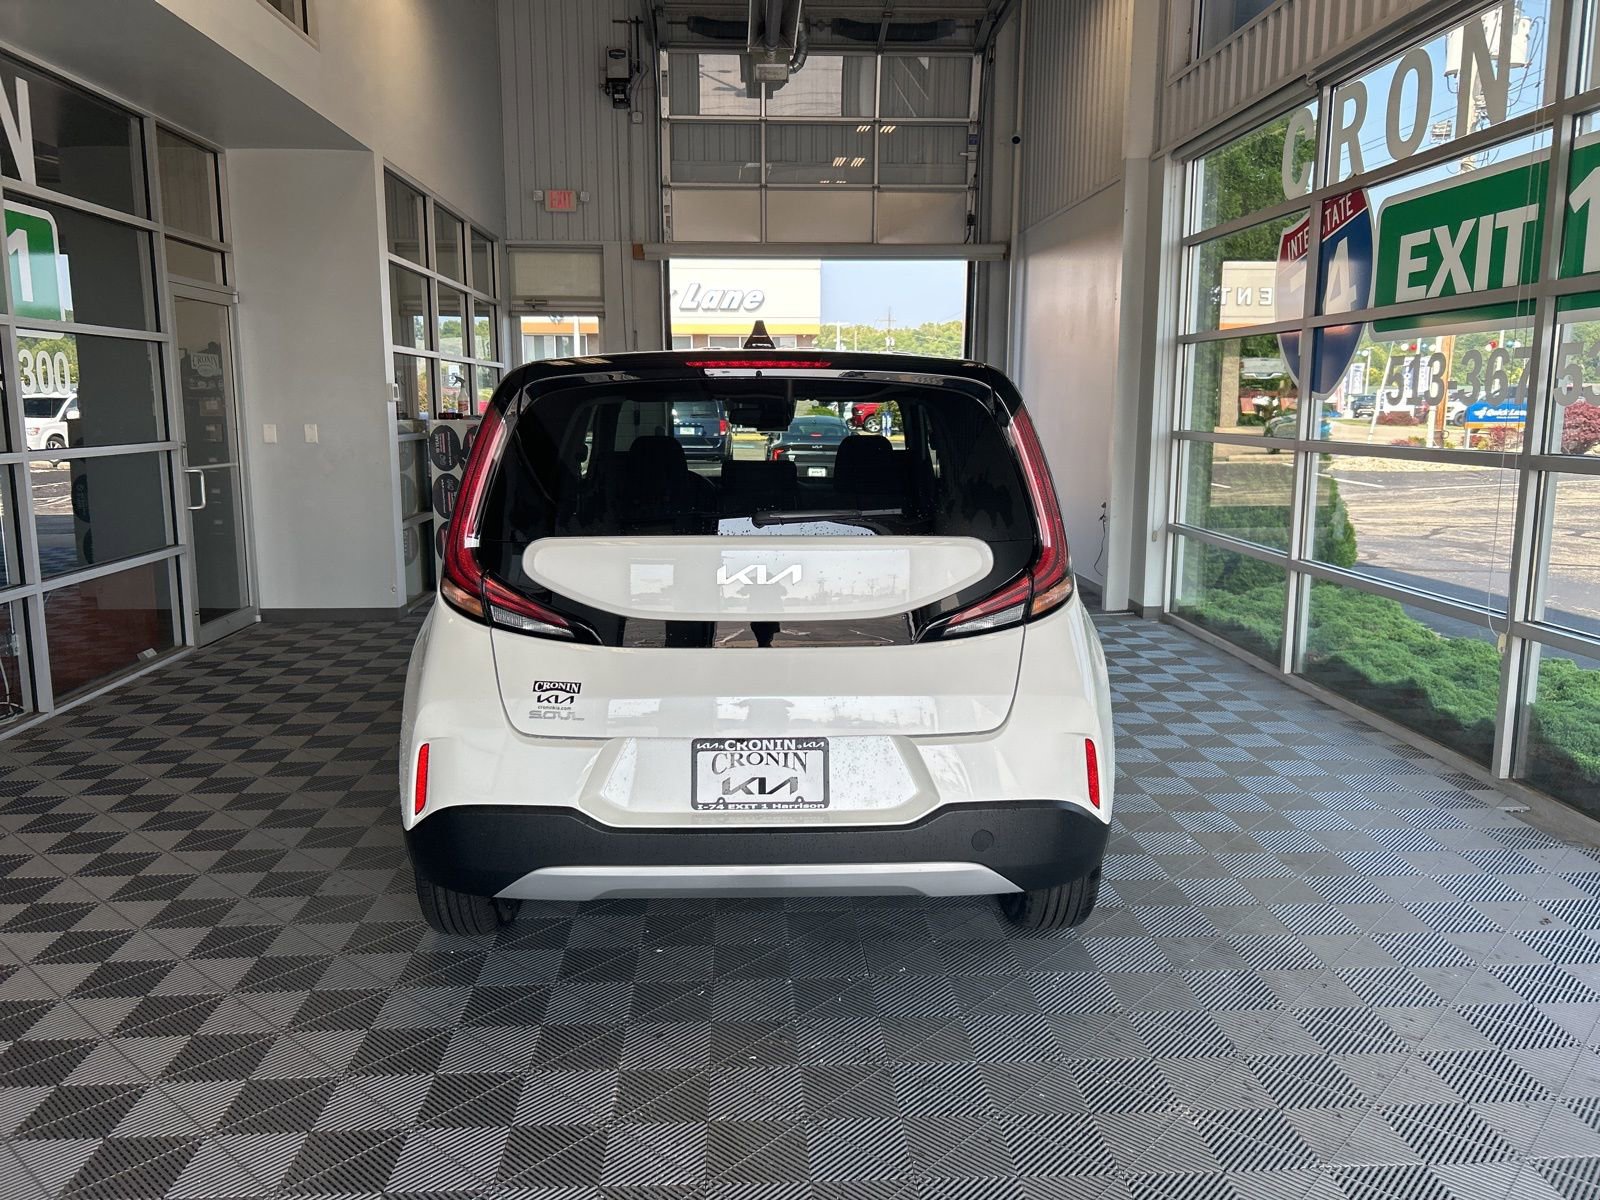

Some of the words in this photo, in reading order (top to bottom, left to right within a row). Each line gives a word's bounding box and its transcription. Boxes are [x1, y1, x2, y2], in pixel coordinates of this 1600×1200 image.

[550, 191, 573, 209] EXIT
[1287, 192, 1354, 262] INTETATE
[1396, 203, 1539, 302] EXIT
[679, 282, 765, 313] Lane
[717, 564, 802, 585] KIA
[534, 681, 580, 693] CRONIN
[536, 694, 575, 704] KIA
[528, 710, 585, 720] SOUL
[724, 739, 796, 751] CRONIN
[711, 751, 809, 775] CRONIN
[721, 776, 799, 796] KIA
